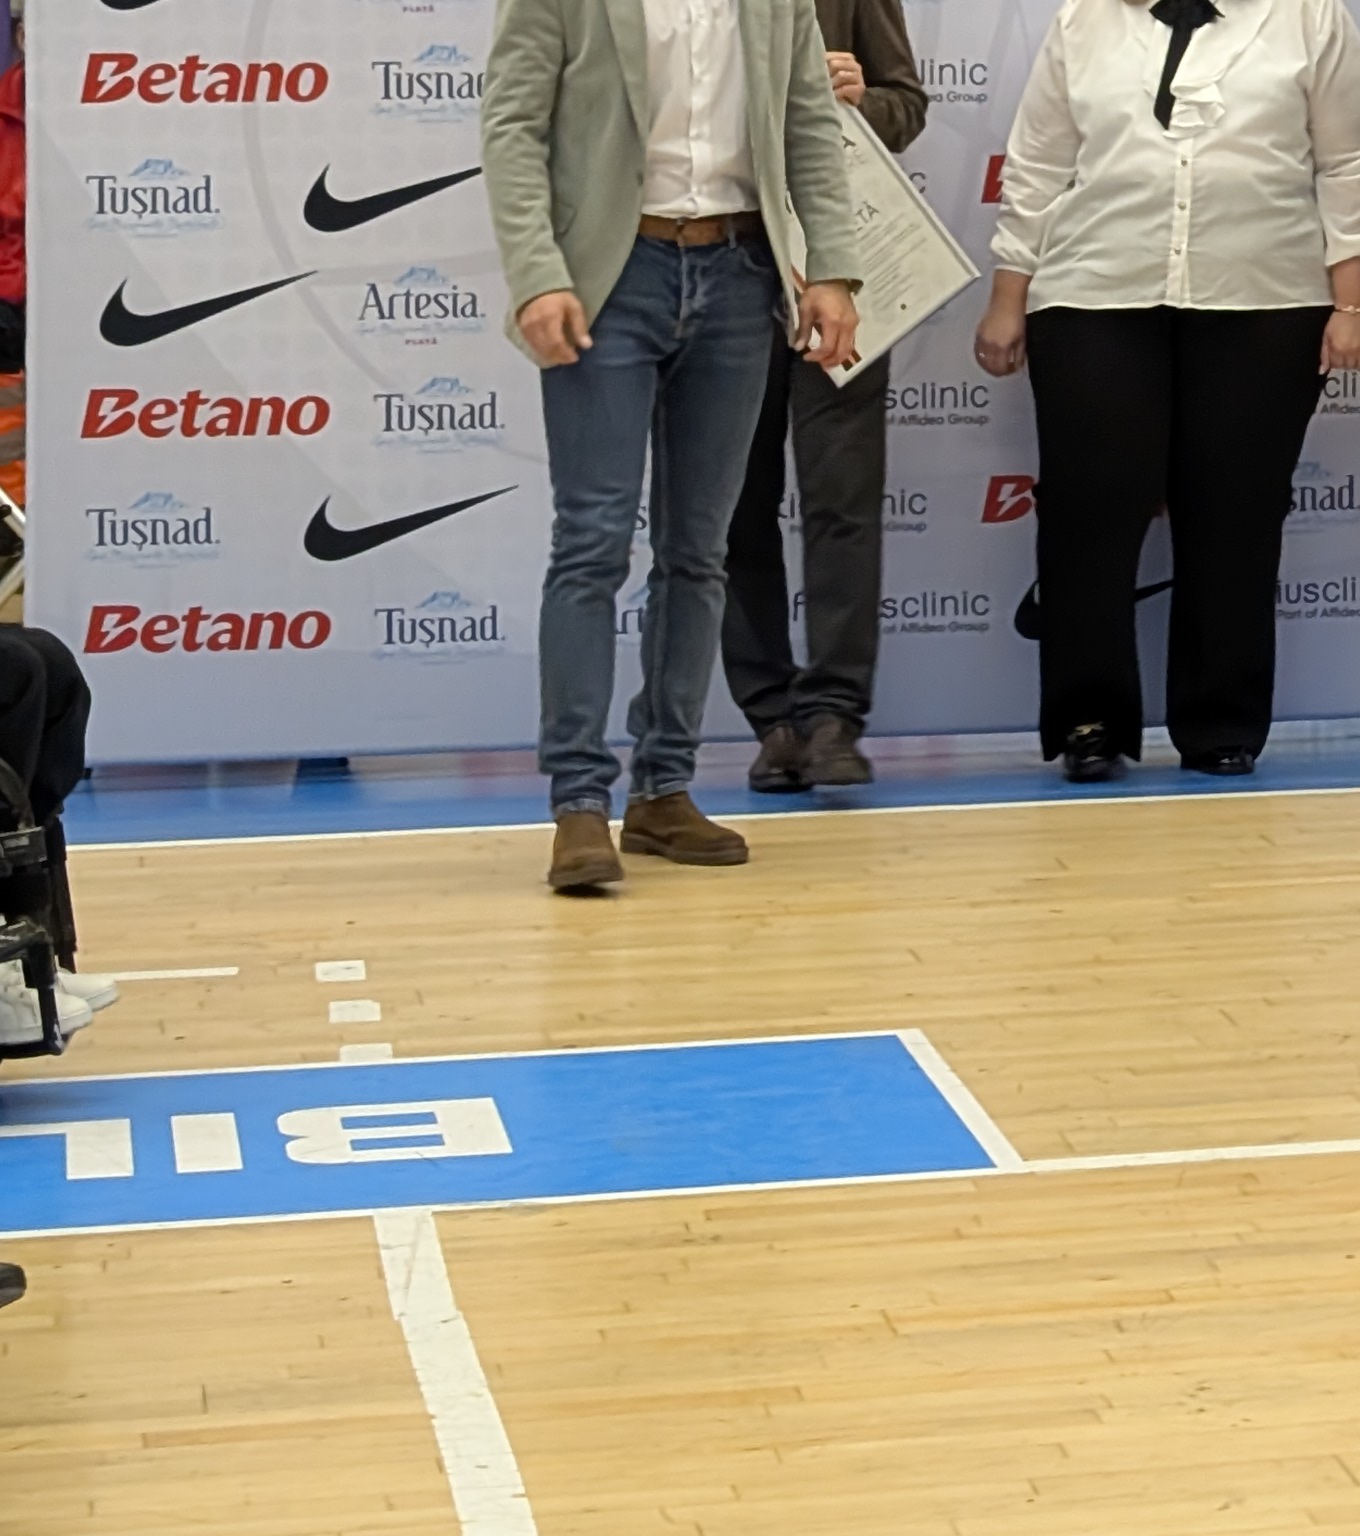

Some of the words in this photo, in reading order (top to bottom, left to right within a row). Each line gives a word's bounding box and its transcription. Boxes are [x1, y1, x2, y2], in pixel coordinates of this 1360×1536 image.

[81, 53, 328, 103] Betano
[81, 389, 330, 438] Betano
[84, 605, 331, 653] Betano
